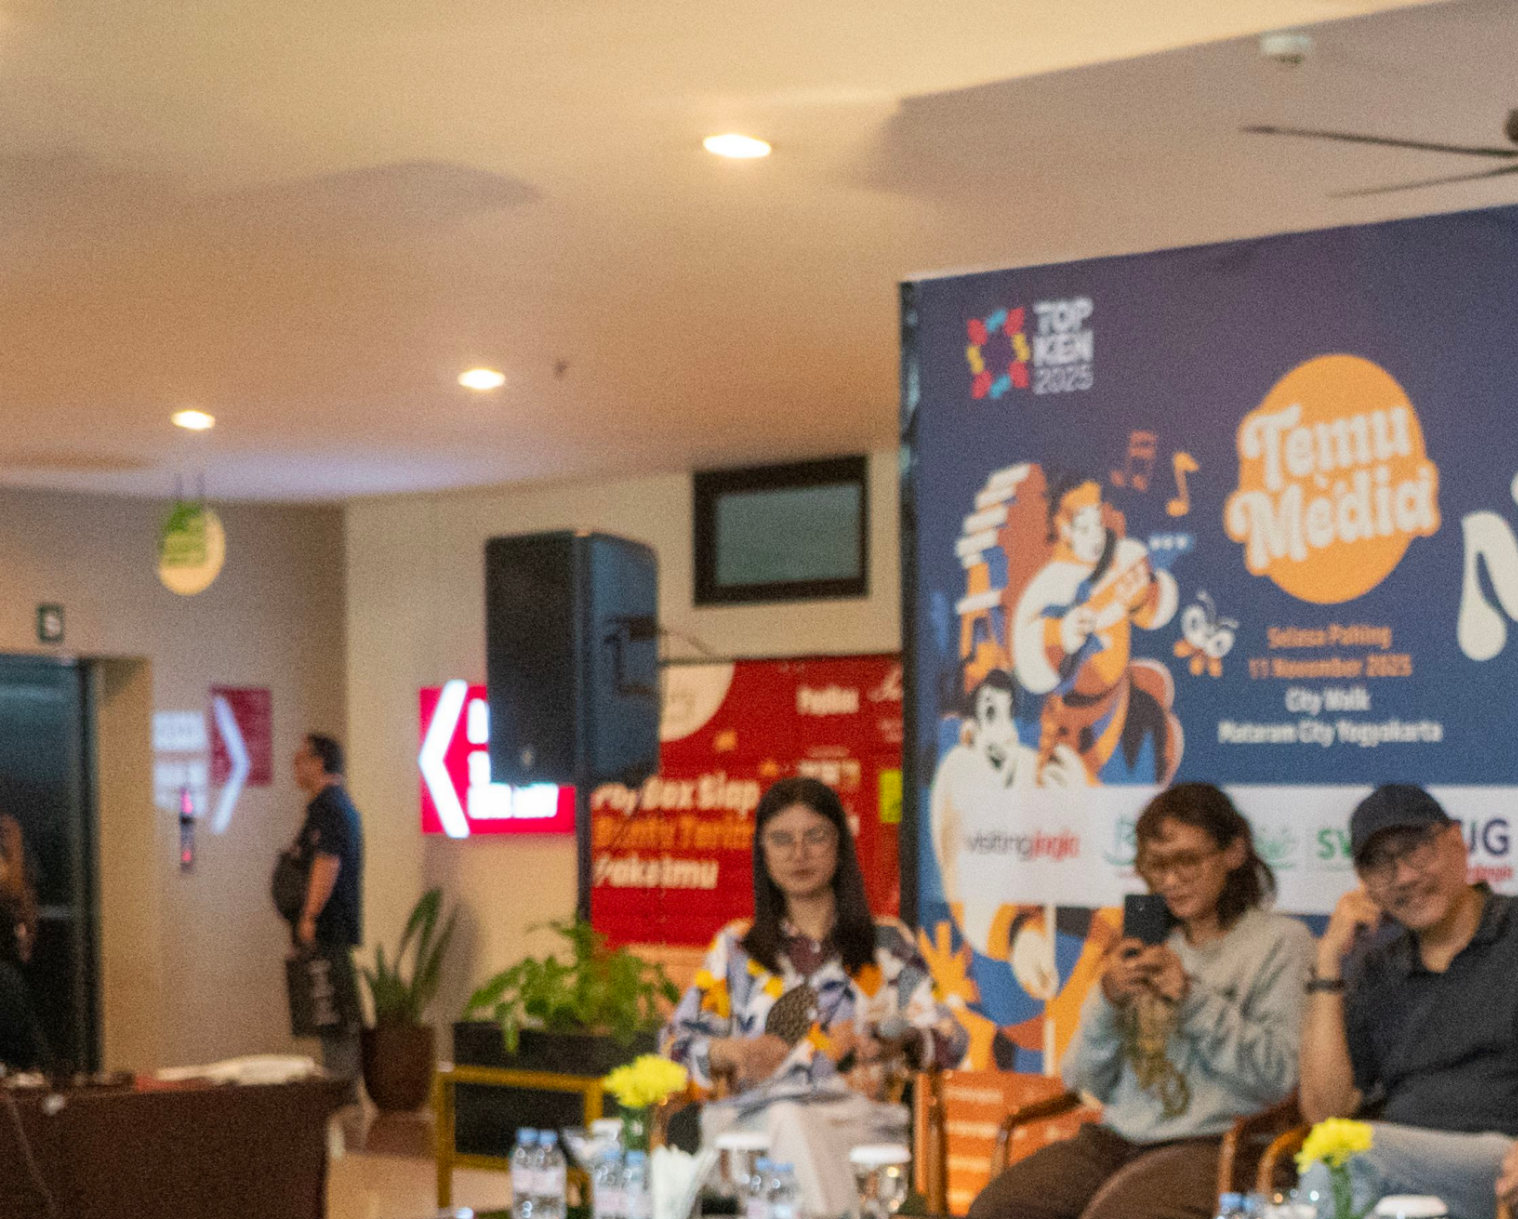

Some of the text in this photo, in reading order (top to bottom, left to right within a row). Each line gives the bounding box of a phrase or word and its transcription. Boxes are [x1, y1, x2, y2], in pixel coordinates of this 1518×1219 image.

[1033, 298, 1094, 336] TOP
[1243, 403, 1411, 491] Temu
[1229, 466, 1437, 570] Media
[1285, 686, 1371, 716] City Walk
[1218, 719, 1443, 748] Mataram City Yogyakarta
